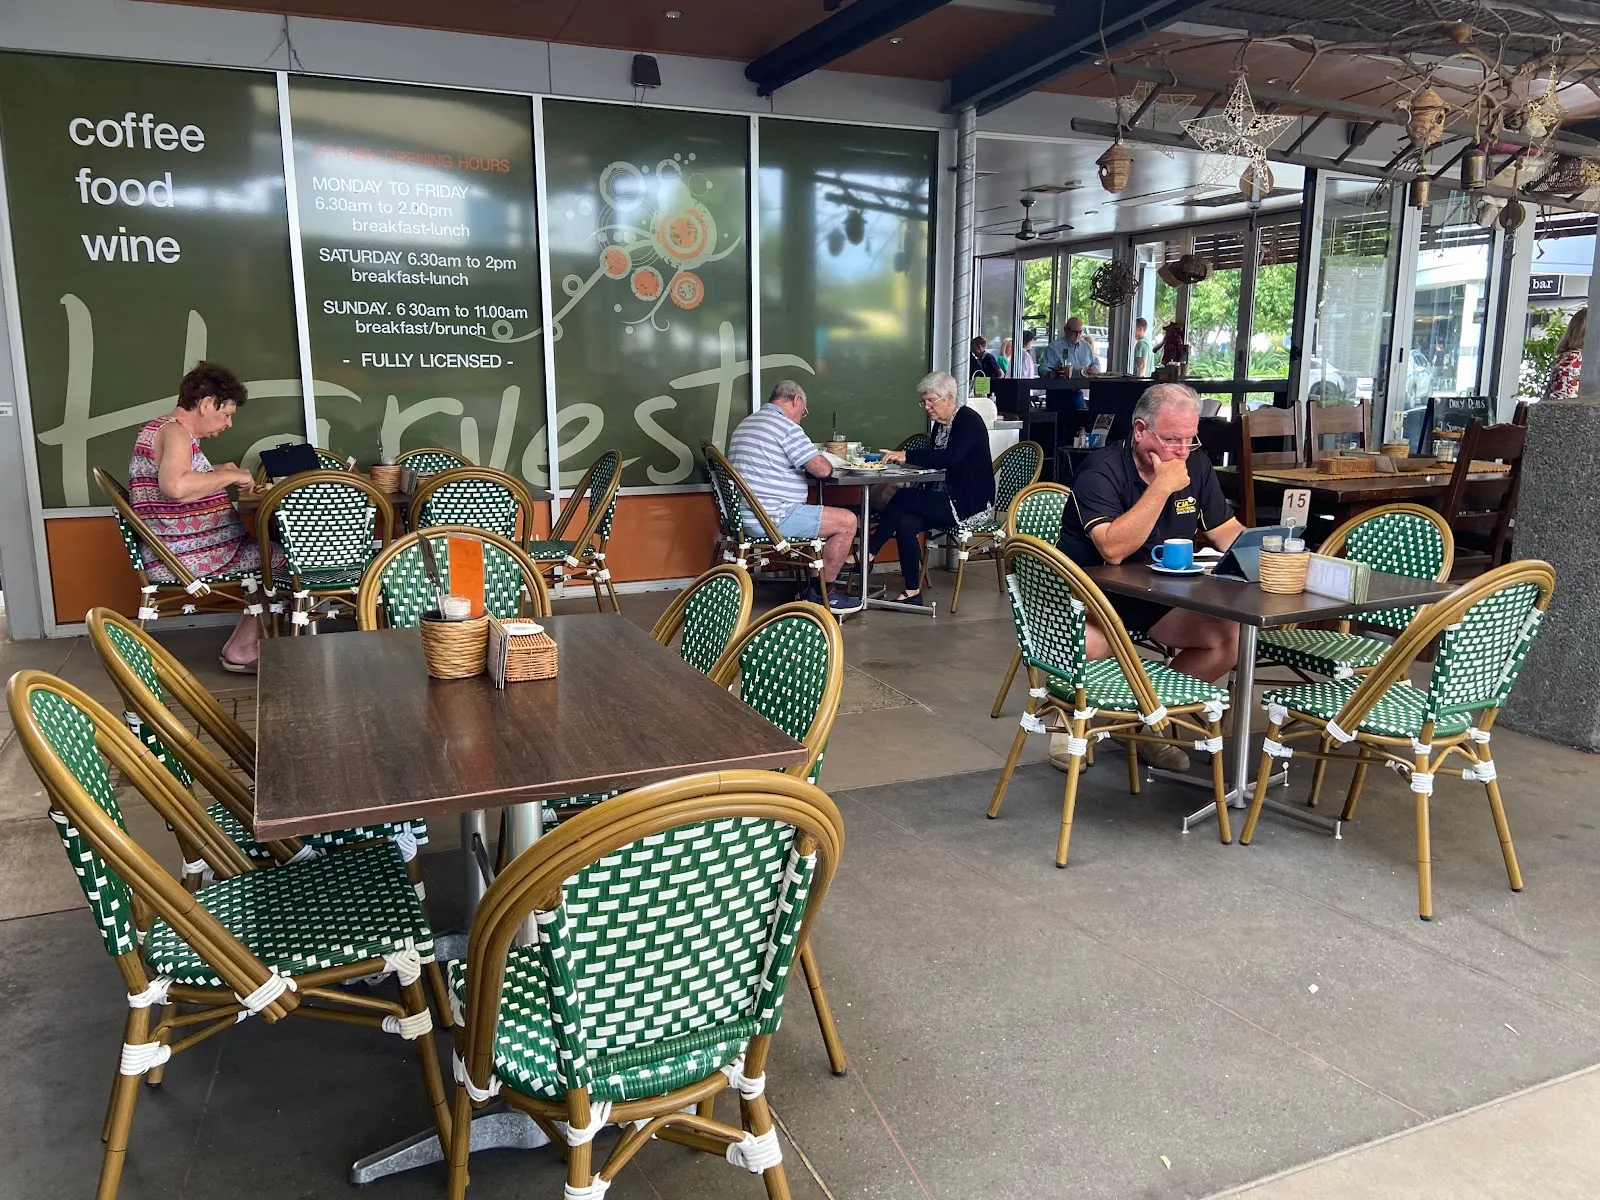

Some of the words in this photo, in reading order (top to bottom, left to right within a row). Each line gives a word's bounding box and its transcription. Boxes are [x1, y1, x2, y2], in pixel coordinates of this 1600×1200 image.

[69, 112, 205, 152] coffee
[384, 149, 453, 169] OPENING
[458, 156, 511, 173] HOURS
[75, 168, 174, 208] food
[312, 176, 383, 194] MONDAY
[388, 181, 410, 196] TO
[416, 184, 469, 199] FRIDAY
[315, 196, 373, 213] 6.30am
[378, 201, 393, 214] to
[398, 202, 453, 218] 2.00pm
[352, 217, 471, 237] breakfast-lunch
[81, 226, 181, 264] wine
[319, 248, 402, 265] SATURDAY
[408, 253, 461, 268] 6.30am
[466, 256, 481, 269] to
[485, 256, 517, 271] 2pm
[351, 268, 469, 286] breakfast-lunch
[1532, 278, 1554, 289] bar
[454, 305, 470, 318] to
[474, 305, 529, 319] 11.00am
[355, 319, 487, 336] breakfast/brunch
[361, 352, 414, 368] FULLY
[419, 353, 502, 368] LICENSED
[1286, 492, 1307, 509] 15
